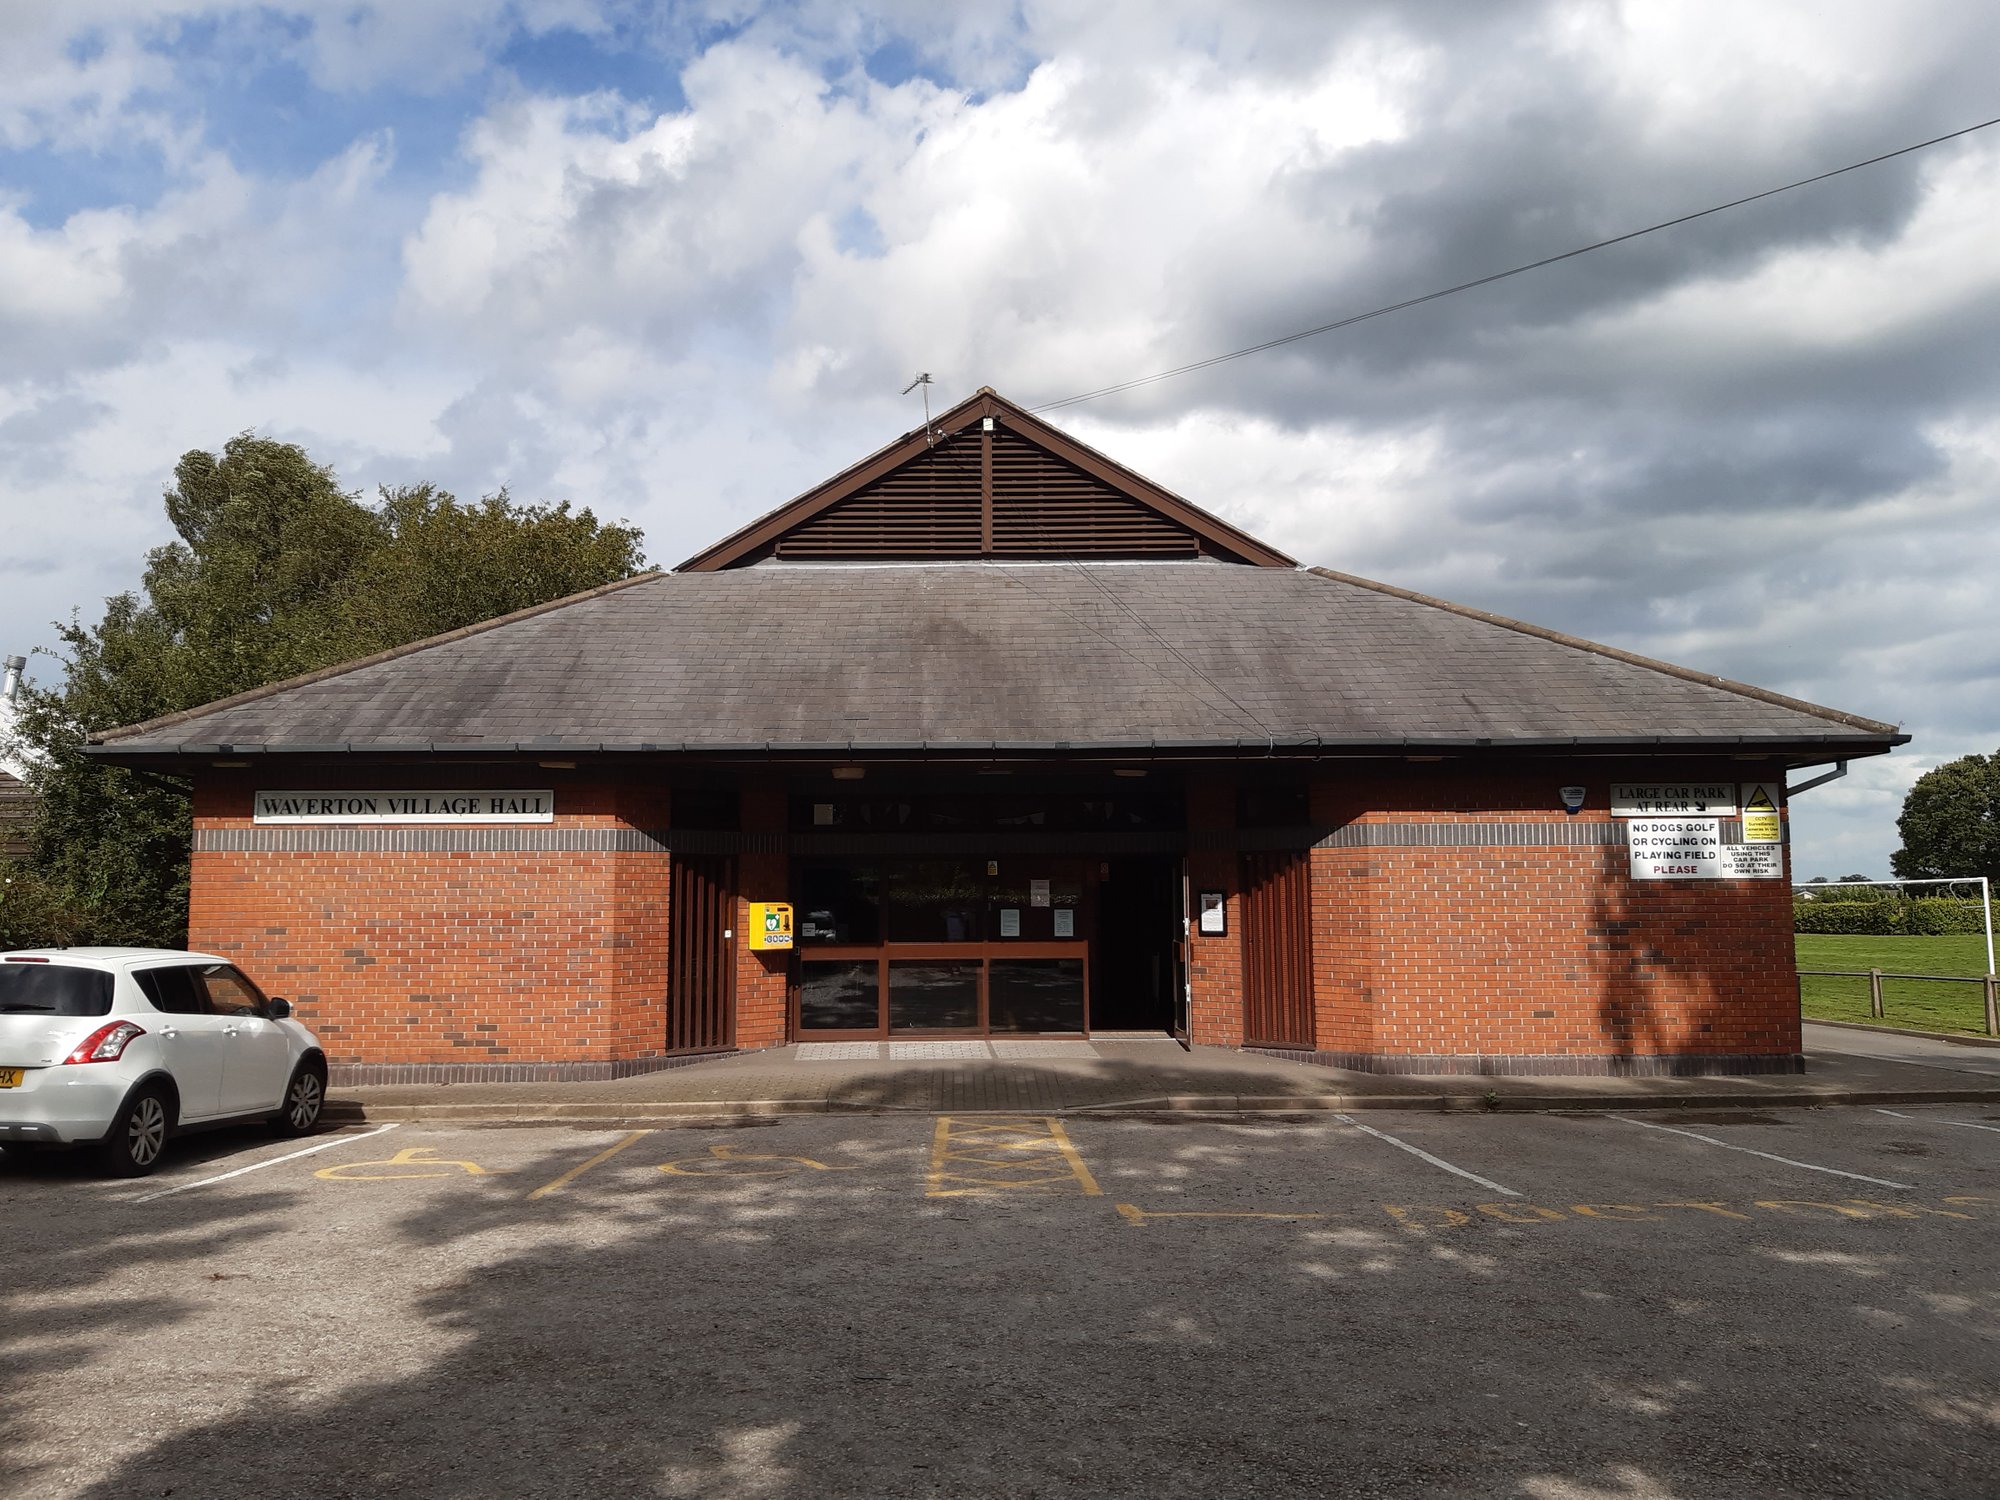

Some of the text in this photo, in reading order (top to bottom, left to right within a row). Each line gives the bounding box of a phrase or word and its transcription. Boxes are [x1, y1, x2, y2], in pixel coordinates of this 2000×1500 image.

[1619, 787, 1726, 799] LARGE CAR PARK
[262, 798, 548, 815] WAVERTON VILLAGE HALL
[1635, 801, 1689, 812] AT REAR
[1632, 823, 1716, 832] NO DOGS GOLF
[1632, 837, 1717, 846] OR CYCLING ON
[1634, 851, 1716, 860] PLAYING FIELD
[1653, 865, 1698, 874] PLEASE
